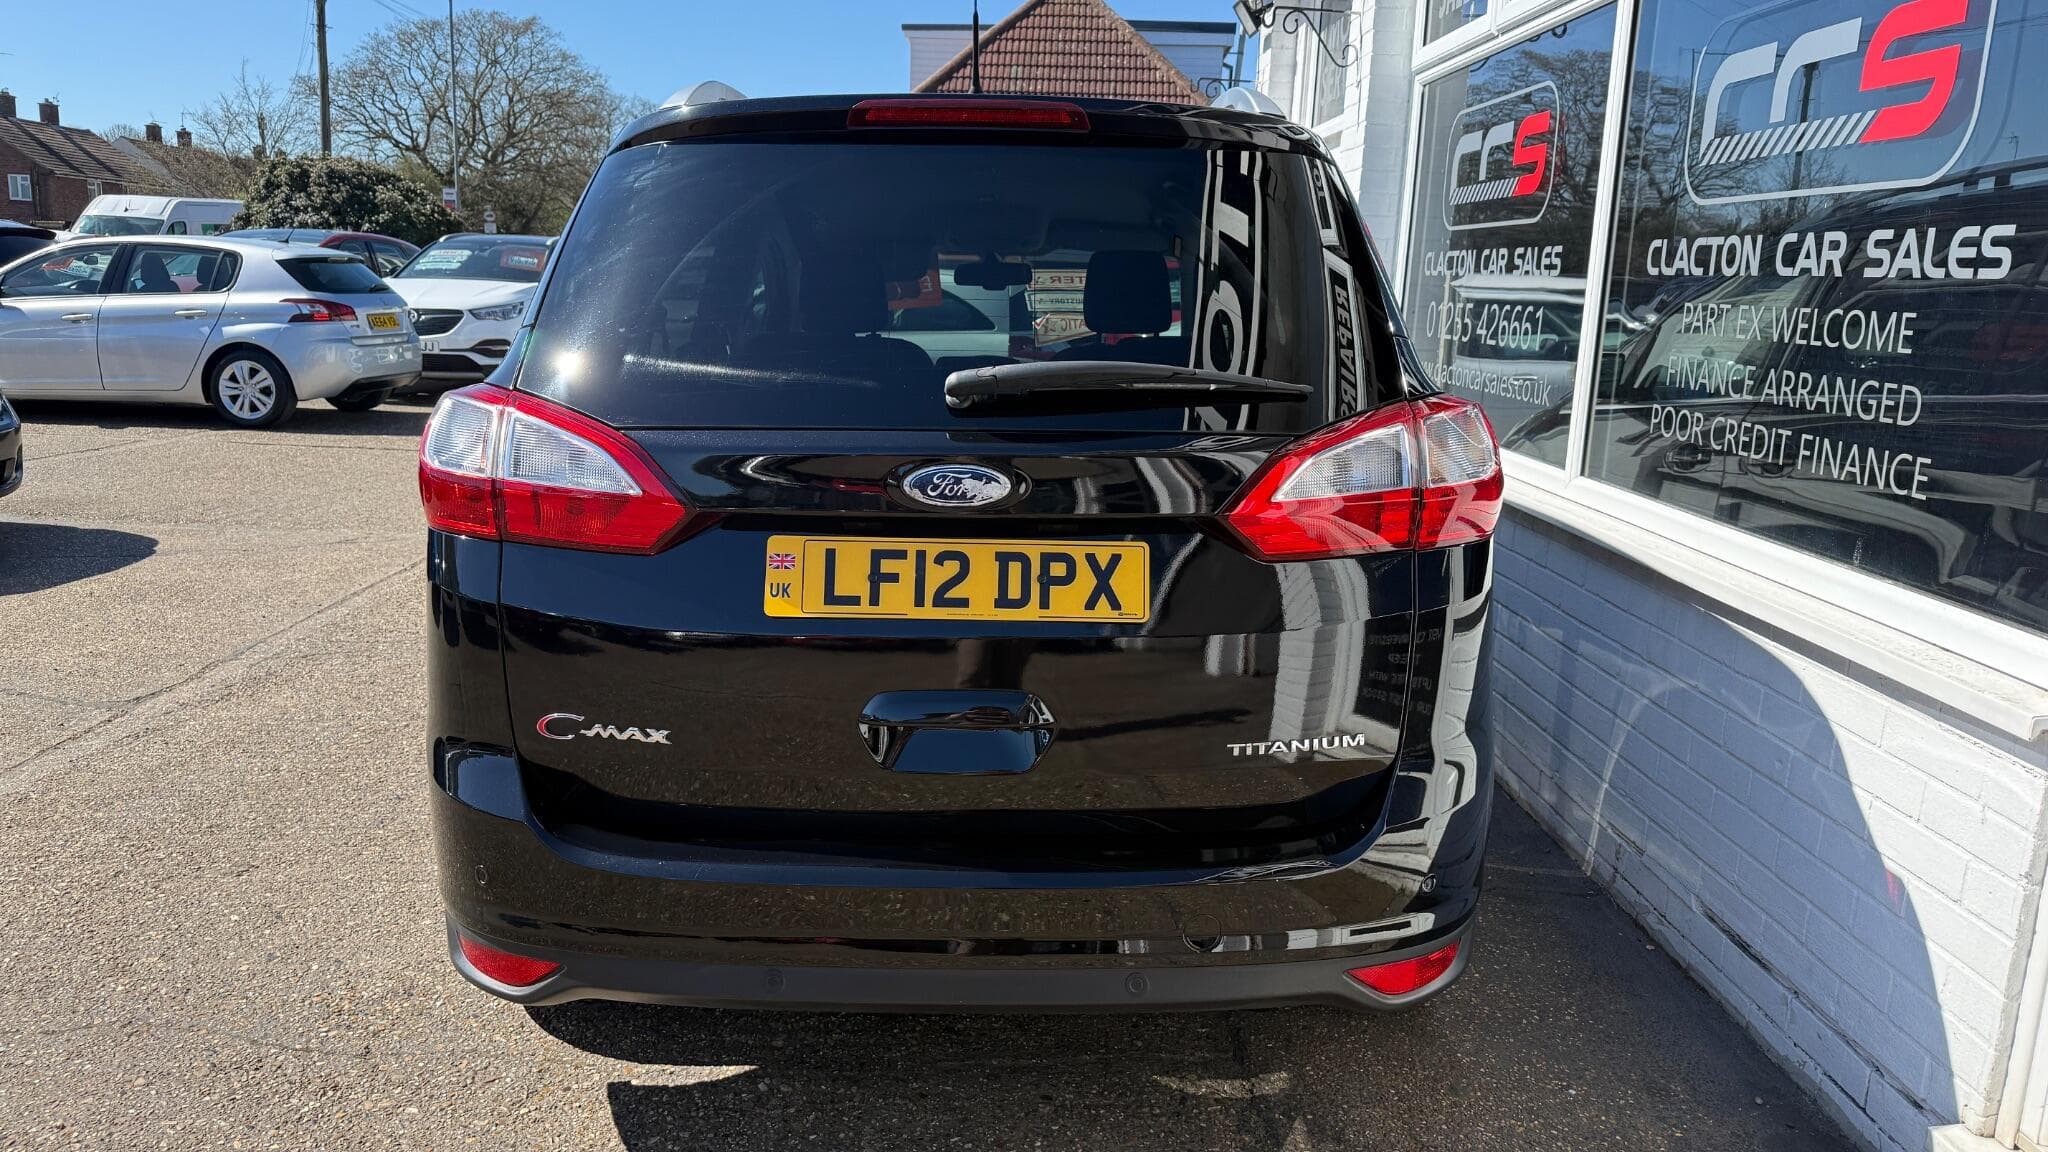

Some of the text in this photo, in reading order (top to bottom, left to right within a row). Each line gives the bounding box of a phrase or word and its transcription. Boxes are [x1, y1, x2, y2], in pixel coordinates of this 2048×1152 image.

[1425, 245, 1563, 277] CLACTON CAR SALES
[1647, 224, 2017, 280] CLACTON CAR SALES
[1426, 301, 1544, 351] 01255 426661
[1681, 302, 1917, 354] PART EX WELCOME
[1666, 355, 1922, 426] FINANCE ARRANGED
[1650, 404, 1932, 500] POOR CREDIT FINANCE
[927, 472, 990, 497] For
[769, 582, 791, 598] UK
[823, 548, 1122, 611] LF12 DPX
[1226, 733, 1366, 757] TITANIUM
